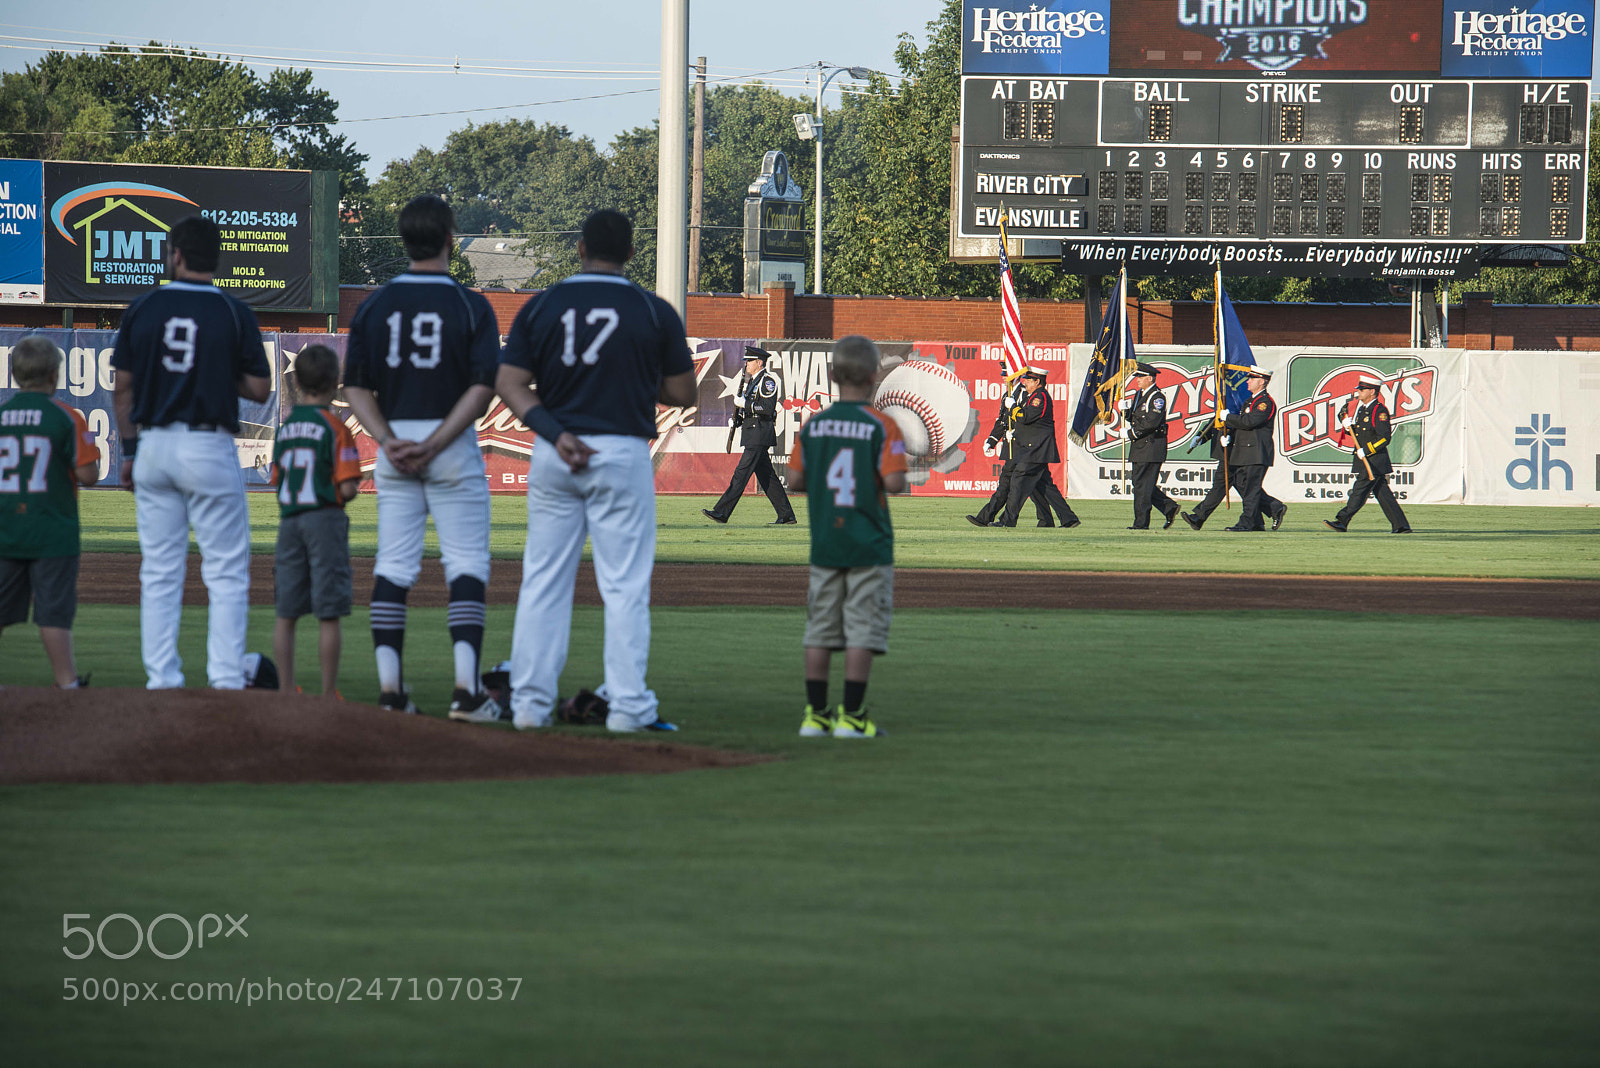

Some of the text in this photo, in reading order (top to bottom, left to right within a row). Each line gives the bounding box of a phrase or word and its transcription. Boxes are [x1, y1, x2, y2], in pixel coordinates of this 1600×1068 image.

[971, 4, 1104, 42] Heritage
[1177, 0, 1367, 26] CHAMPIONS
[1452, 7, 1586, 45] Heritage
[981, 30, 1062, 53] Federal
[1247, 34, 1301, 53] 2016
[1461, 33, 1543, 56] Federal
[991, 81, 1068, 100] AT BAT
[1134, 83, 1190, 102] BALL
[1245, 84, 1321, 104] STRIKE
[1390, 84, 1433, 104] OUT
[1523, 84, 1570, 104] H/E
[1104, 151, 1581, 169] 1 2 3 4 5 6 7 8 9 10 RUNS HITS ERR
[976, 175, 1073, 195] RIVER CITY
[0, 223, 21, 234] IAL
[220, 230, 287, 241] OLD MITIGATION
[94, 230, 167, 260] JMT
[220, 242, 289, 253] TER MITIGATION
[1070, 244, 1126, 260] "When
[1131, 244, 1221, 265] Everybody
[93, 261, 164, 274] RESTORATION
[232, 267, 265, 276] MOLD &
[1381, 267, 1456, 276] Benjamin Bosse
[104, 274, 155, 285] SERVICES
[212, 278, 286, 289] WATER PROOFING
[161, 316, 199, 374] 9
[385, 310, 444, 370] 19
[560, 307, 620, 368] 17
[945, 345, 977, 360] Your
[1026, 345, 1066, 361] Team
[0, 435, 52, 493] 27
[279, 448, 317, 505] 17
[826, 447, 856, 508] 4
[1385, 470, 1415, 485] rill
[1110, 484, 1122, 495] &
[1305, 488, 1317, 498] &
[1320, 488, 1343, 498] Ice
